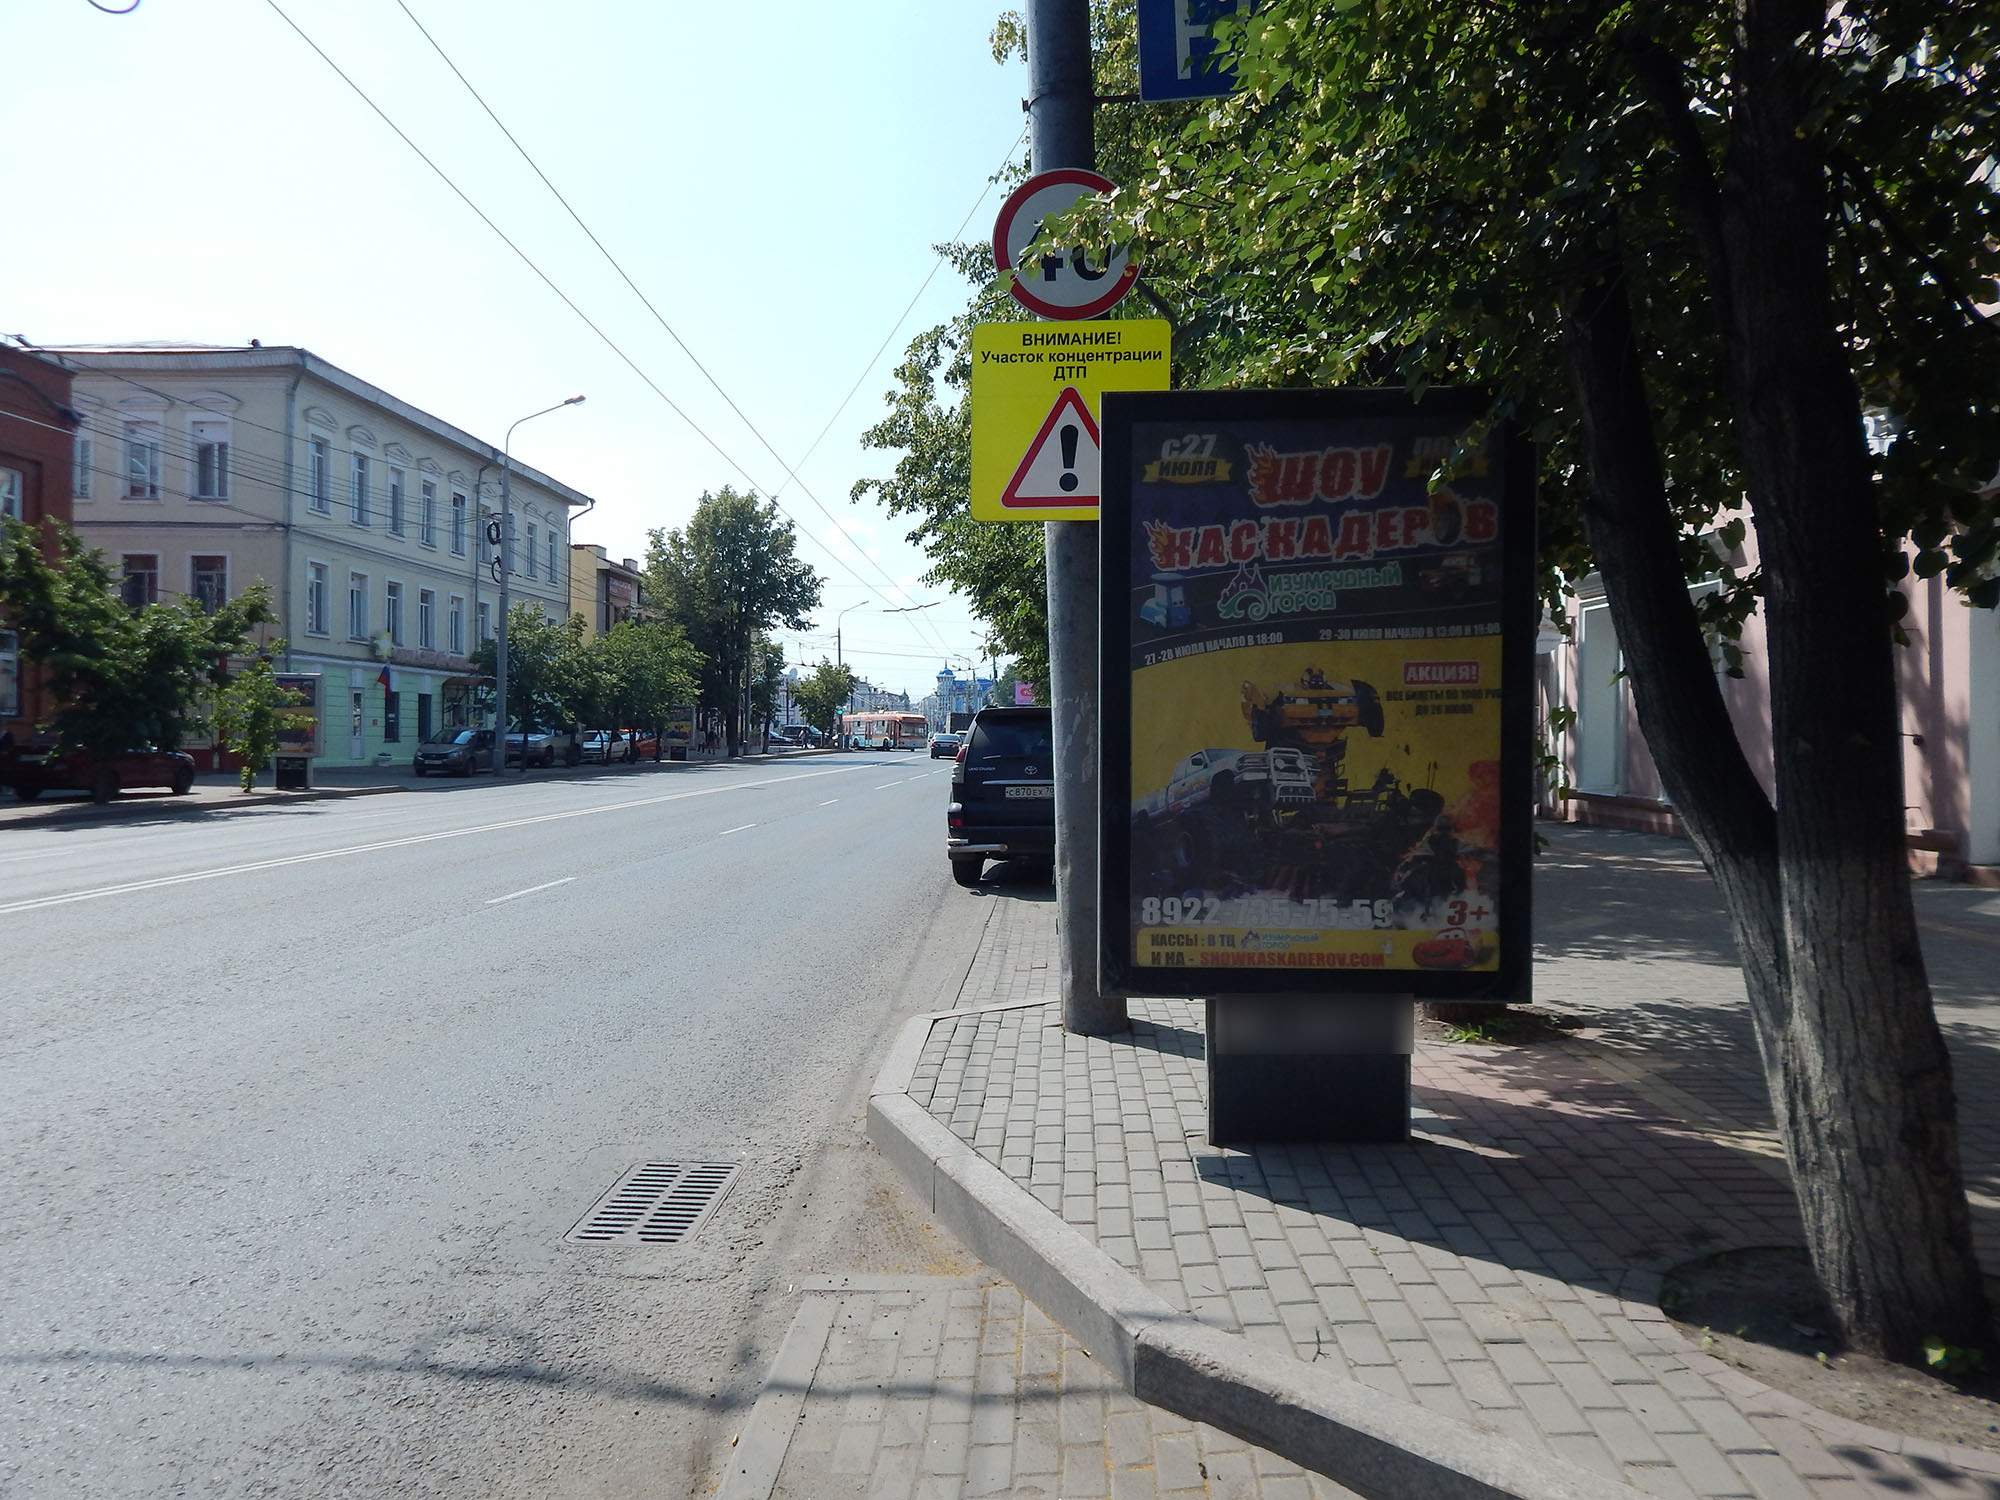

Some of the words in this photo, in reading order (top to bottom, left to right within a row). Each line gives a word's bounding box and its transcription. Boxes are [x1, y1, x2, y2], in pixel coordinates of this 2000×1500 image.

[1022, 332, 1121, 346] ВНИМАНИЕ!
[981, 351, 1043, 363] Участок
[1049, 350, 1162, 363] концентрации
[1053, 366, 1087, 381] ДТП
[1158, 460, 1217, 476] ИЮЛЯ
[1245, 442, 1393, 508] ШОУ
[1268, 561, 1403, 592] ИЗУМРУДНЫЙ
[1270, 590, 1336, 614] ГОРОД
[1384, 626, 1424, 639] НАЧАЛО
[1174, 642, 1205, 659] ИЮЛЯ
[1206, 636, 1246, 652] НАЧАЛО
[1247, 634, 1255, 646] В
[1256, 632, 1283, 645] 18:00
[1406, 665, 1477, 683] АКЦИЯ!
[1447, 900, 1489, 926] 3+
